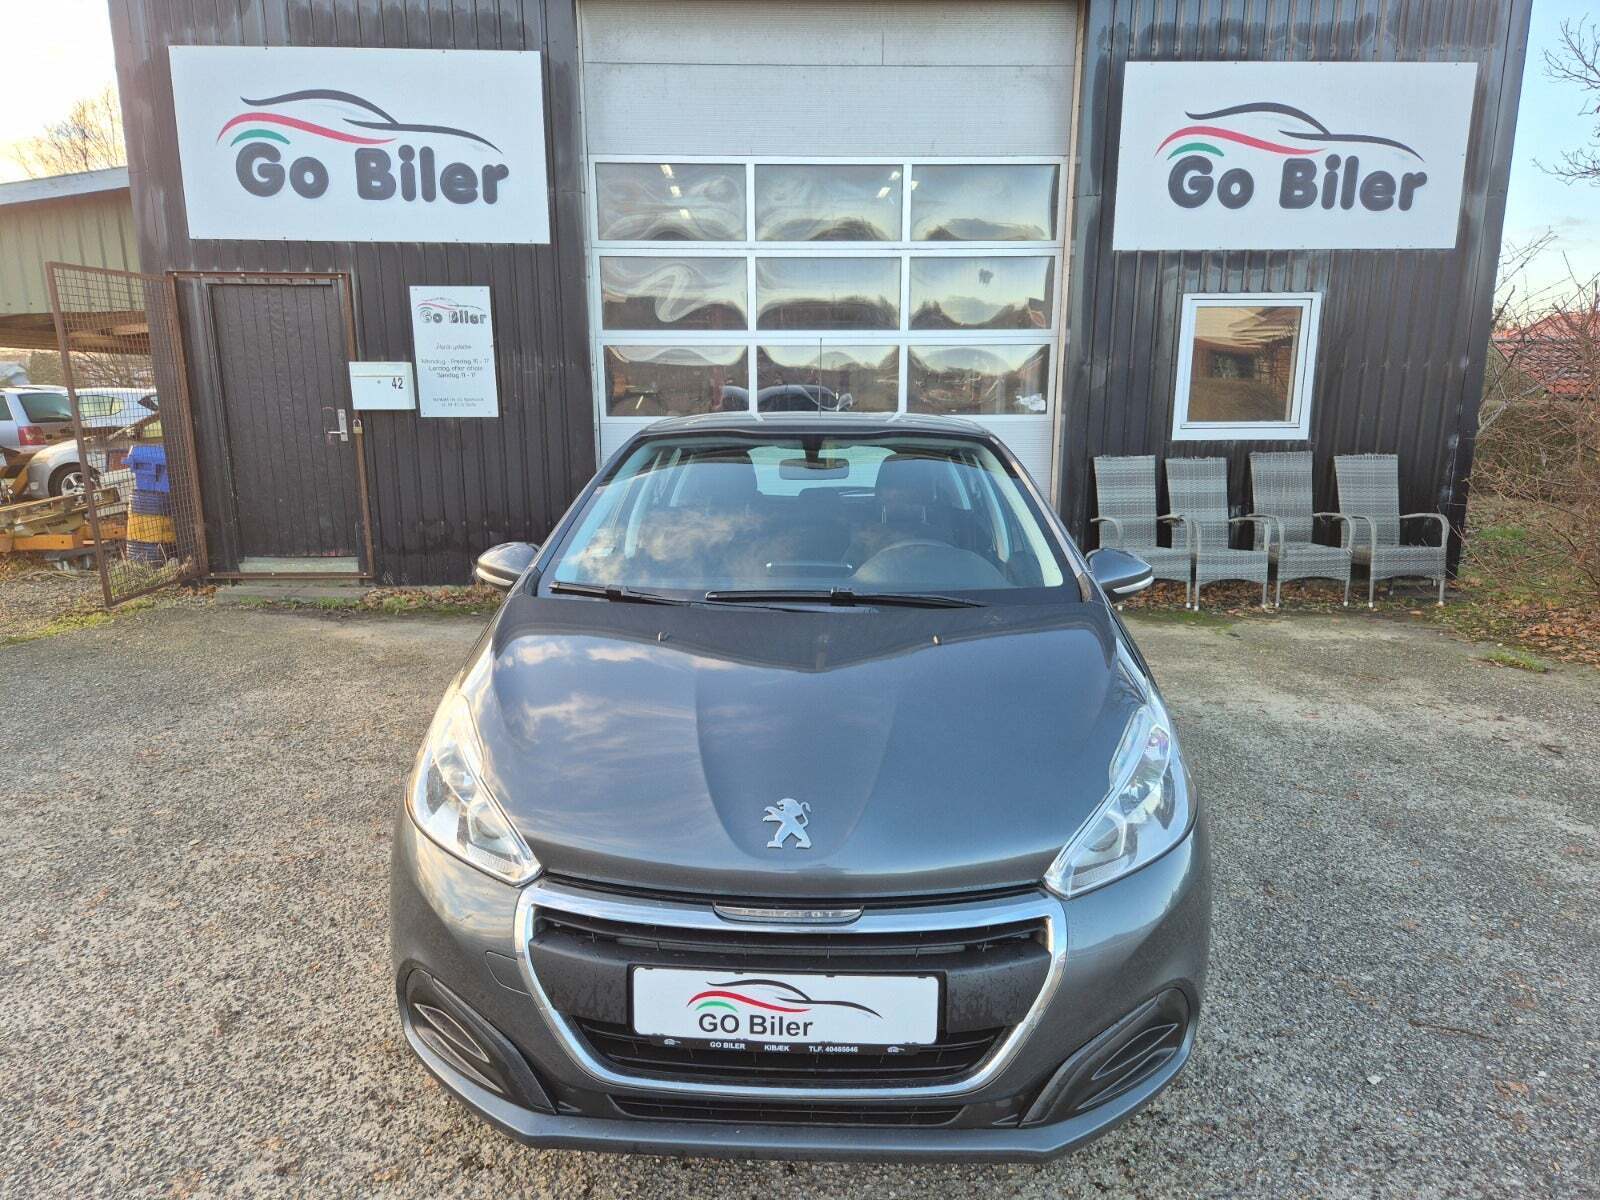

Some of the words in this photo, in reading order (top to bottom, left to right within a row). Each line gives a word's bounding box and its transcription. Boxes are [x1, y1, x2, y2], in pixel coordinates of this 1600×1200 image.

[235, 141, 330, 199] Go
[354, 143, 510, 205] Biler
[1167, 154, 1255, 210] Go
[1278, 153, 1428, 212] Biler
[420, 310, 443, 323] Go
[448, 309, 487, 324] Biler
[391, 376, 404, 390] 42
[698, 1013, 740, 1034] GO
[749, 1014, 814, 1036] Biler
[709, 1041, 722, 1049] GO
[723, 1042, 746, 1050] BILER
[764, 1043, 790, 1052] KIBÆK
